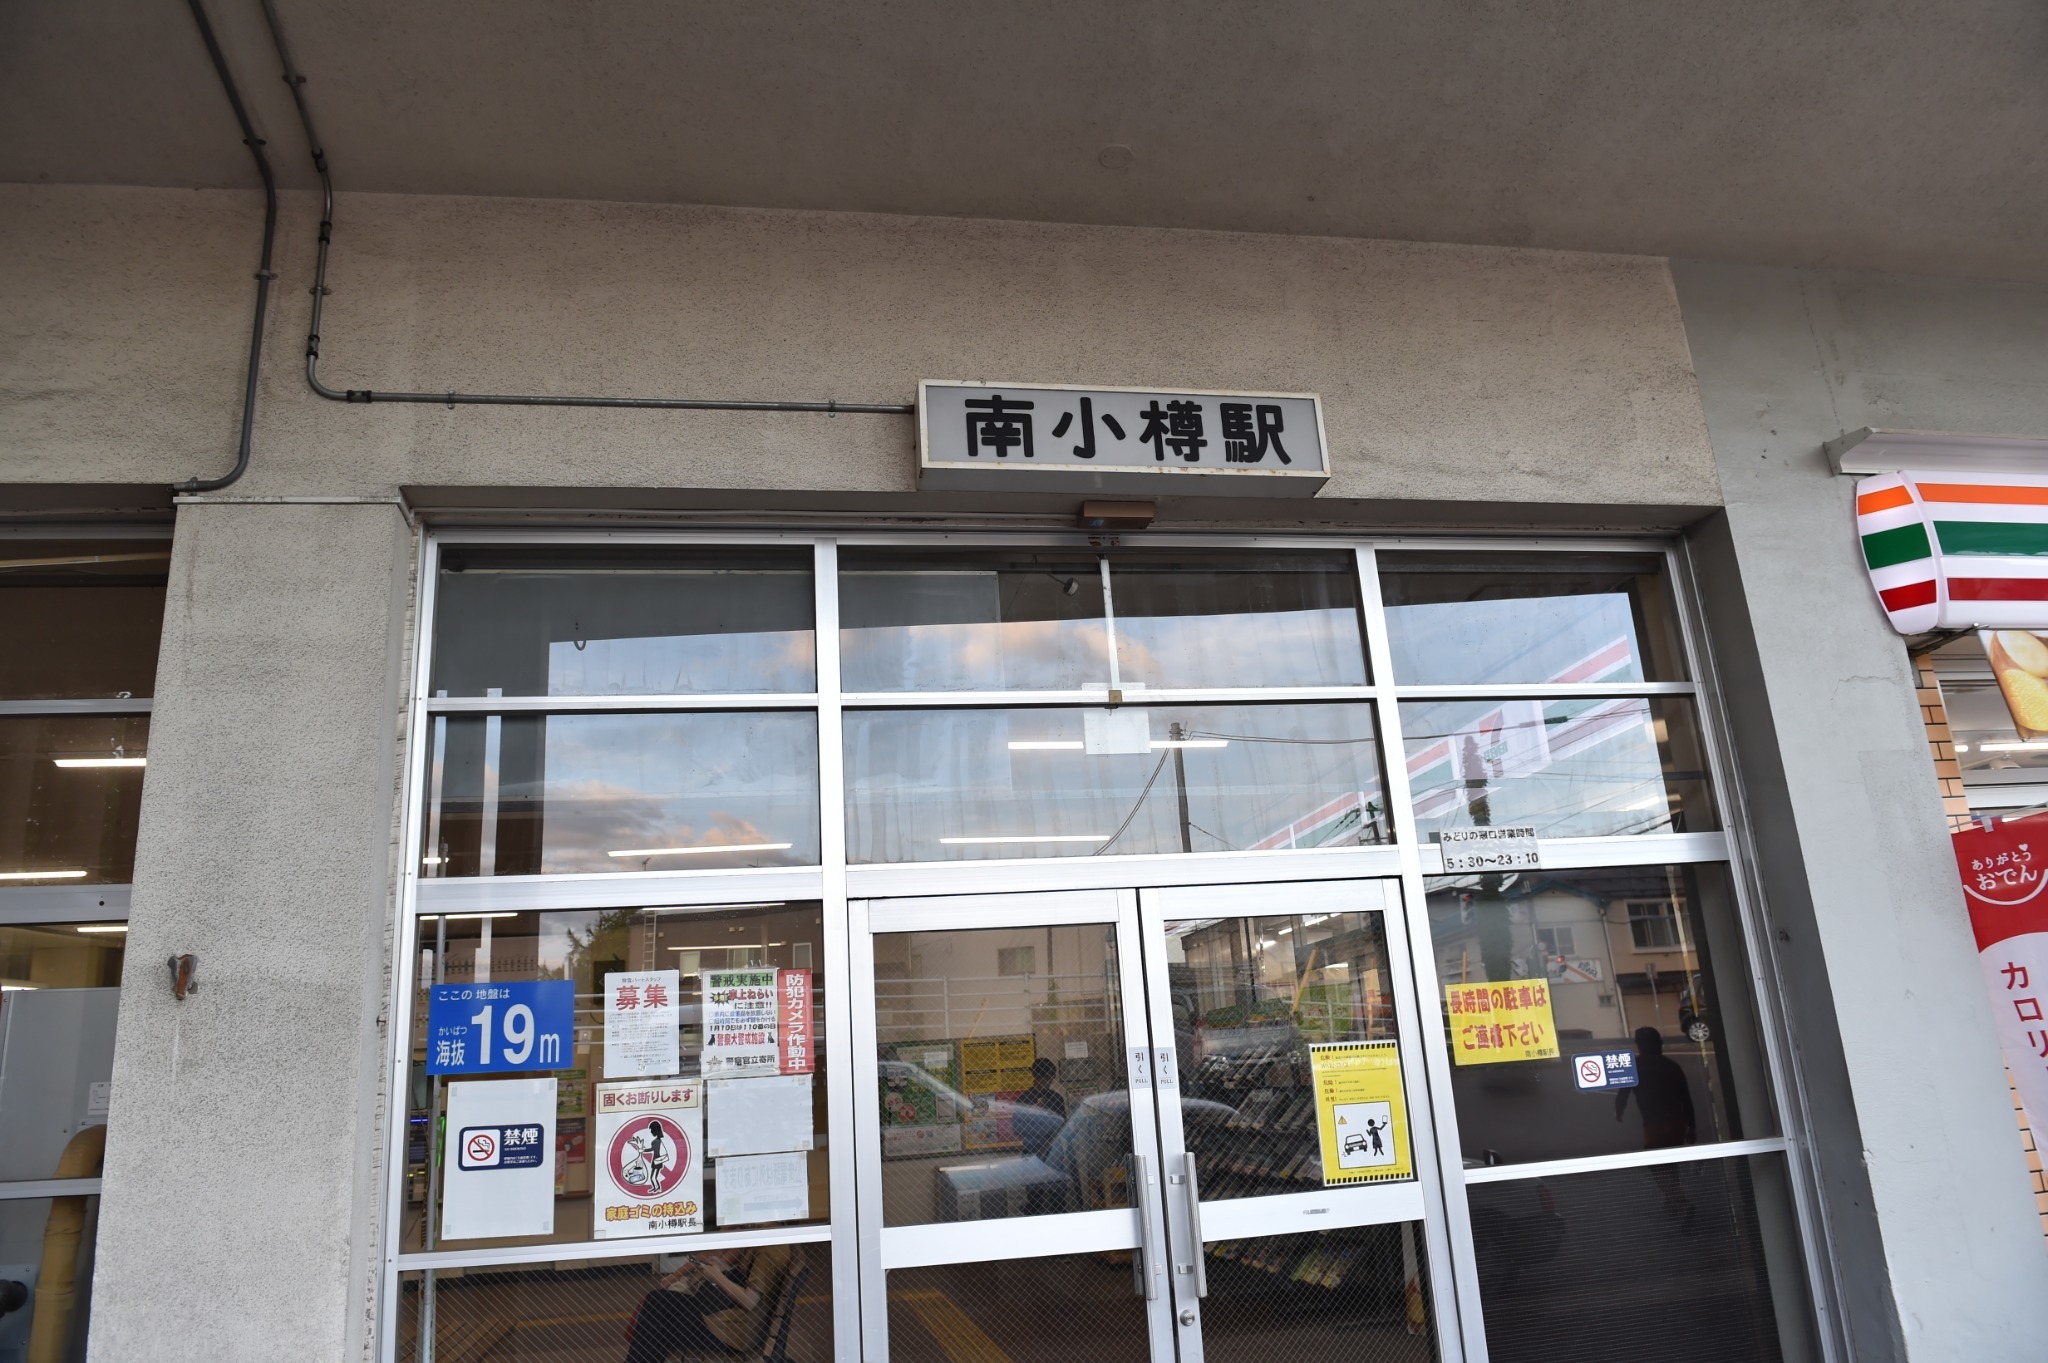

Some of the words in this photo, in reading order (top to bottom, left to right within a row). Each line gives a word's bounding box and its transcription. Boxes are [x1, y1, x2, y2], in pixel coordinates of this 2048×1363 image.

[965, 394, 1292, 465] 南小樽駅
[1443, 827, 1535, 842] みどりの窓口営業時間
[1971, 851, 2032, 870] ありがとう
[1976, 864, 2038, 891] おでん
[710, 973, 774, 987] 警戒実施中
[439, 990, 473, 1001] ここの
[475, 988, 511, 1000] 地盤は
[616, 984, 668, 1011] 募集
[1450, 985, 1547, 1014] 長時間の駐車は
[438, 1025, 468, 1036] かいばつ
[785, 973, 806, 1070] 防犯カメラ作動中
[1462, 1021, 1544, 1050] ご遠慮下さい
[435, 1039, 466, 1067] 海抜
[1135, 1052, 1144, 1074] 引く
[1605, 1052, 1633, 1069] 禁煙
[1160, 1053, 1169, 1075] 引く
[603, 1088, 694, 1107] 固くお断りします
[503, 1127, 539, 1146] 禁煙
[605, 1201, 698, 1222] 家庭ゴミの持込み
[648, 1217, 697, 1230] 南小樽駅長
